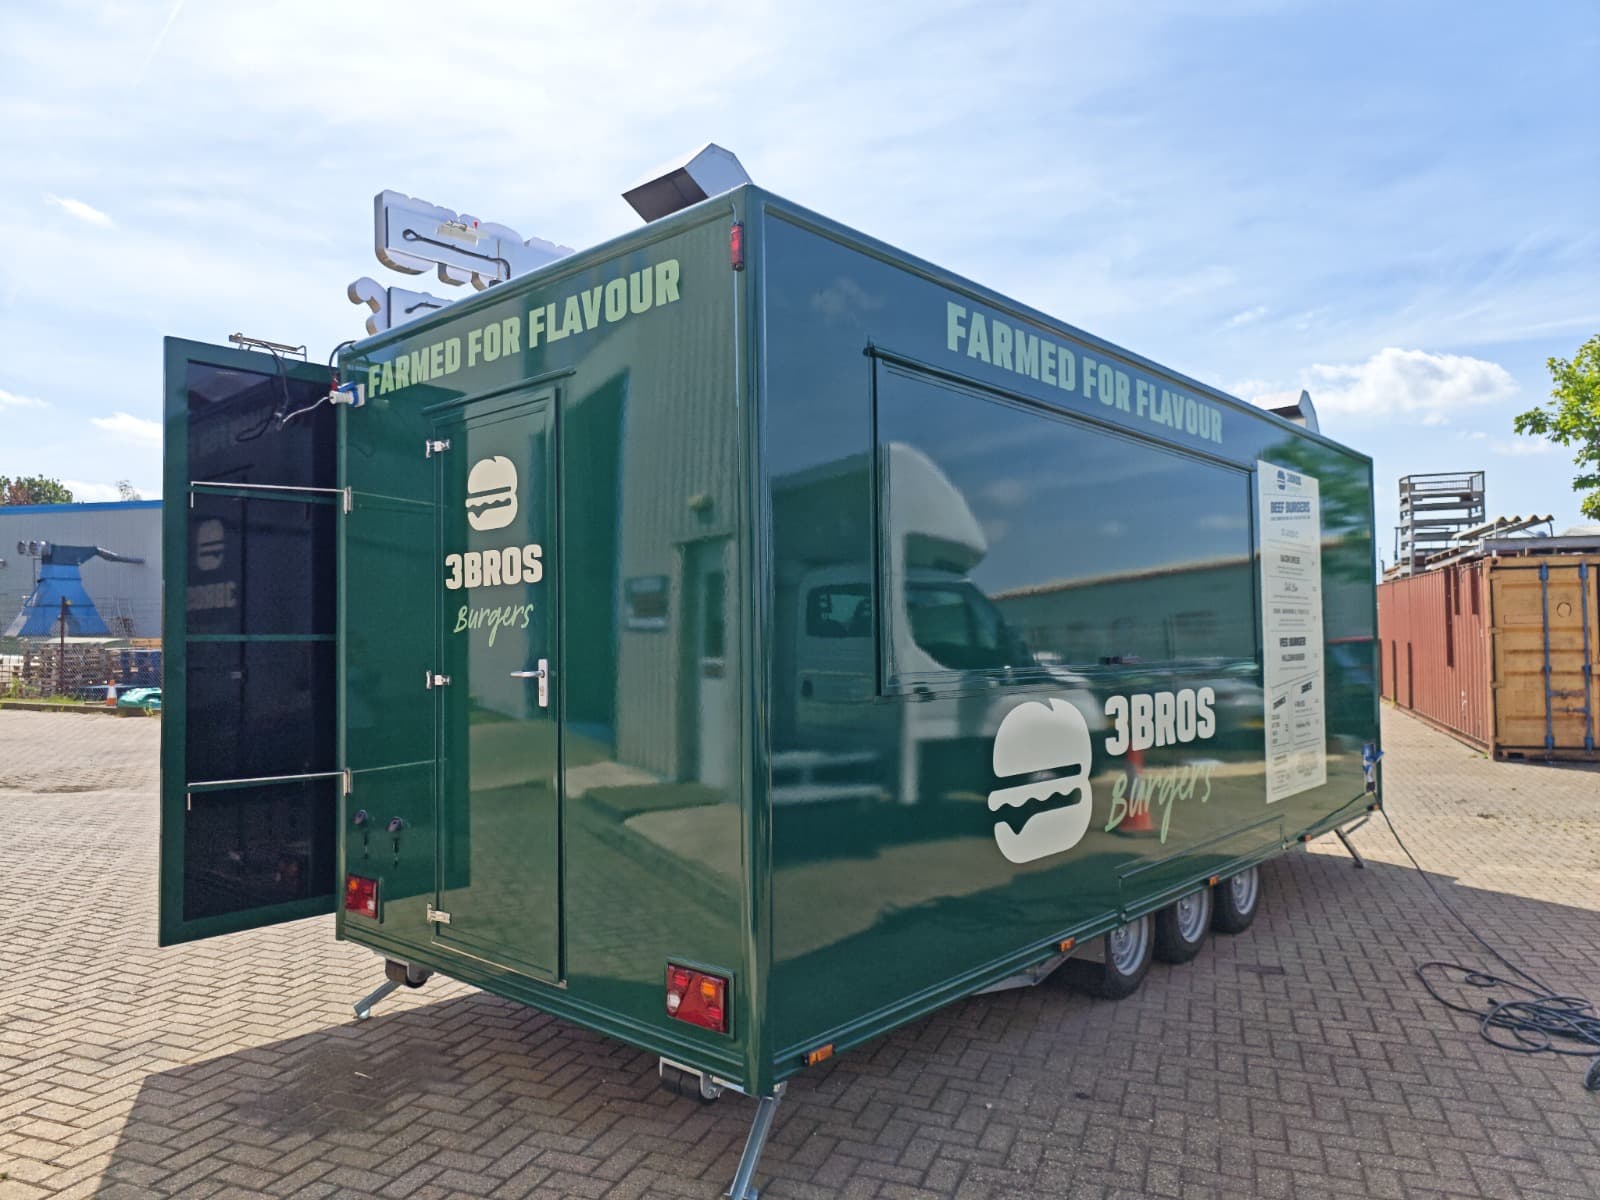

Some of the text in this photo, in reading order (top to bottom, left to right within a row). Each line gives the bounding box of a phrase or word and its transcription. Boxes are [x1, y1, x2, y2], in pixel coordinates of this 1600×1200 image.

[368, 258, 680, 398] FARMED FOR FLAVOUR
[946, 301, 1223, 444] FARMED FOR FLAVOUR
[445, 543, 543, 590] 3BROS
[453, 603, 534, 647] Burgers
[1104, 686, 1216, 756] 3BROS
[1104, 763, 1216, 845] Burgers
